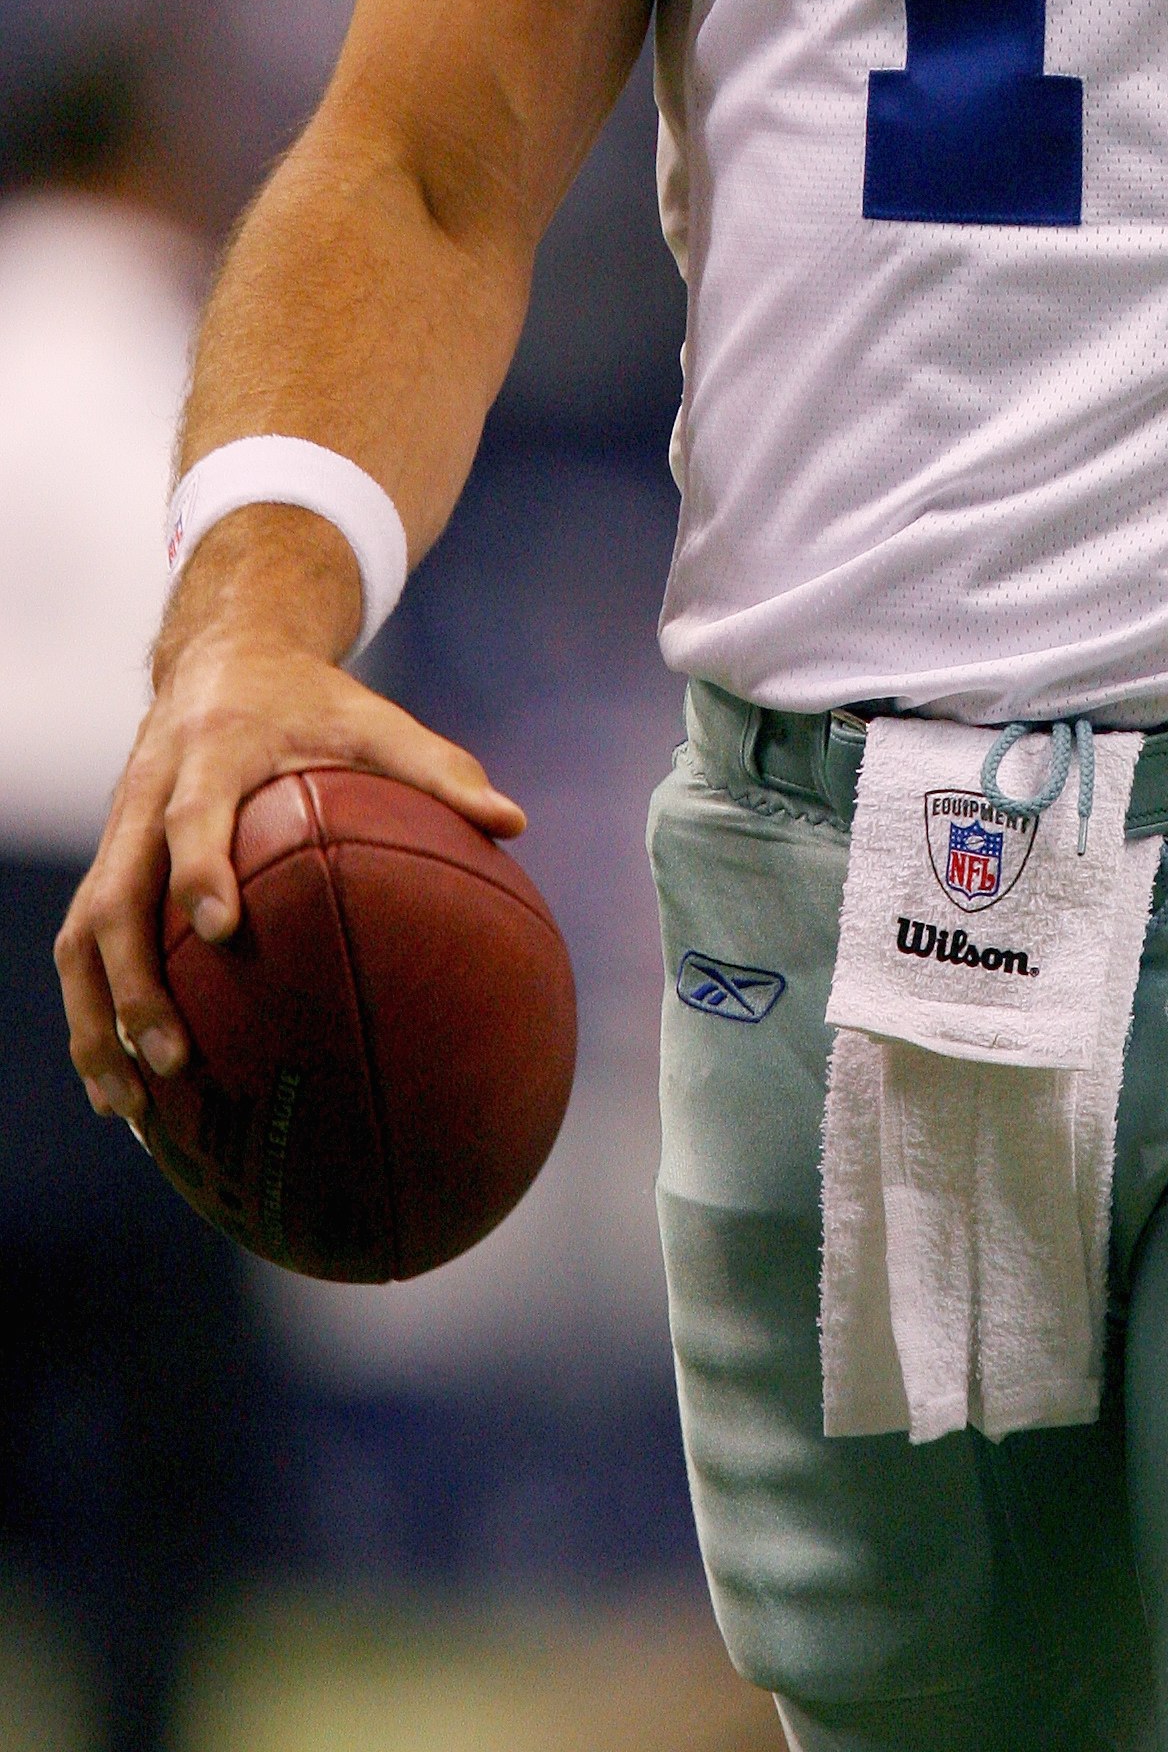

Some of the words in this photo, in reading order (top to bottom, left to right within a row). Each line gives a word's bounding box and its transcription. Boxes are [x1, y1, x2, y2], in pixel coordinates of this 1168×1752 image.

[949, 850, 996, 893] NFL
[896, 917, 1029, 976] Wilson
[266, 1067, 302, 1159] LEAGUE
